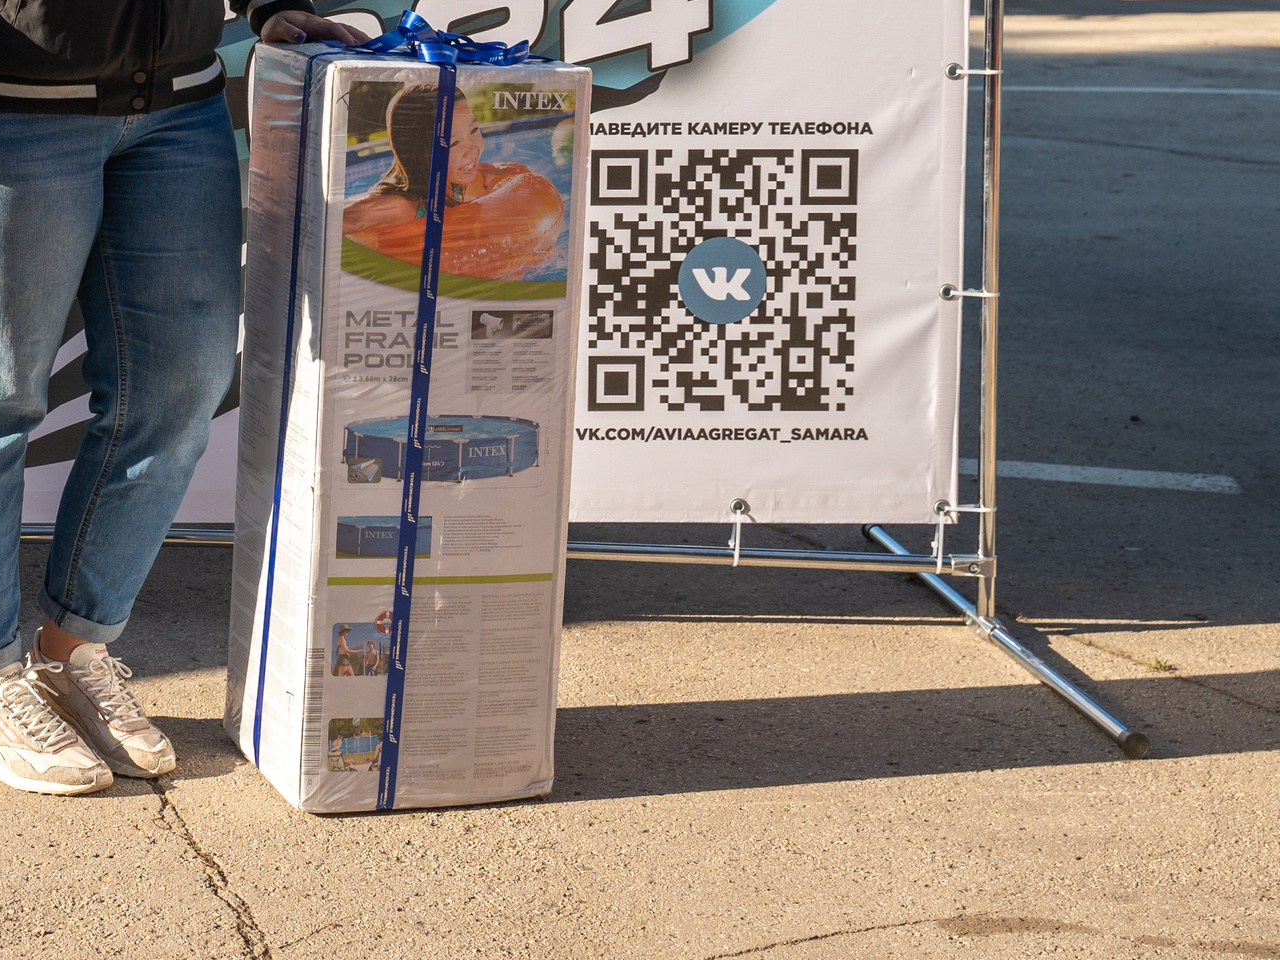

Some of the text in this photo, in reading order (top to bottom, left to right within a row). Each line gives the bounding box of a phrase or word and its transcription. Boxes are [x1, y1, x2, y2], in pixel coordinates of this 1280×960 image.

[493, 90, 569, 111] INTEX
[687, 122, 764, 136] КАМЕРУ
[768, 121, 874, 136] ТЕЛЕФОНА
[345, 310, 455, 328] METL
[344, 331, 459, 349] FRAE
[575, 426, 869, 443] VK.COM/AVIAAGREGAT_SAMARA
[468, 445, 507, 458] INTEX
[365, 531, 395, 539] INTEX
